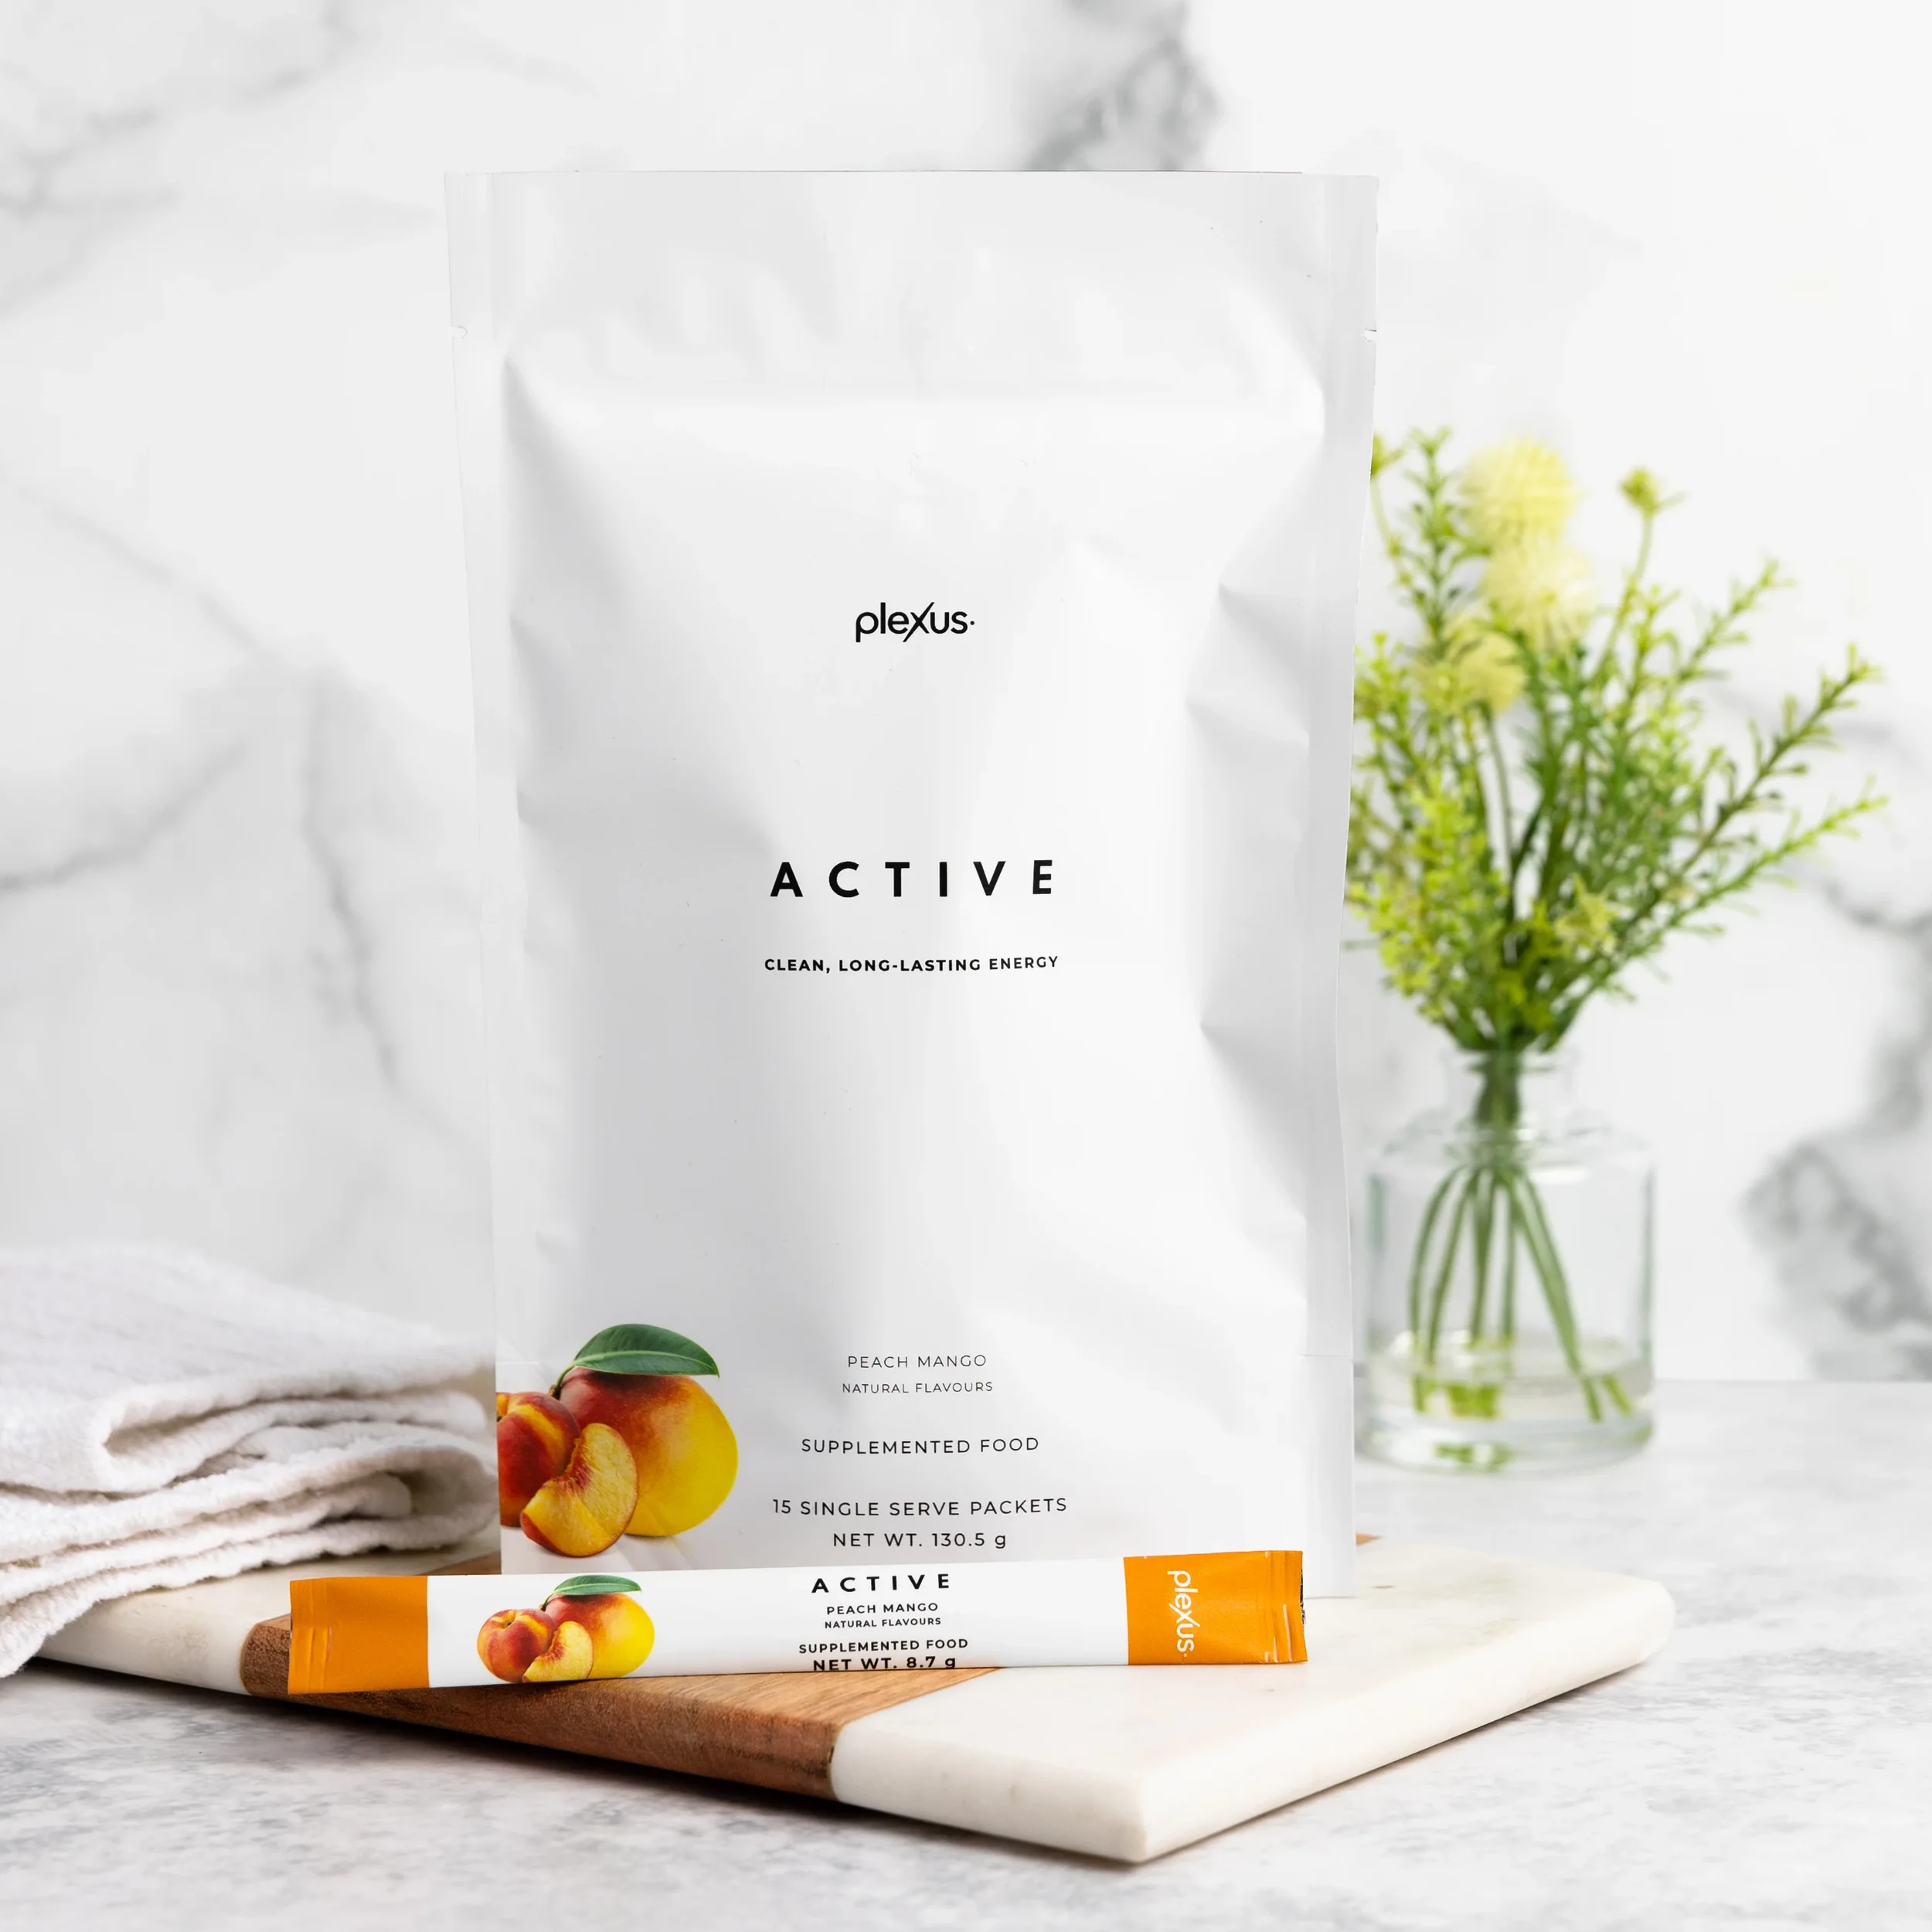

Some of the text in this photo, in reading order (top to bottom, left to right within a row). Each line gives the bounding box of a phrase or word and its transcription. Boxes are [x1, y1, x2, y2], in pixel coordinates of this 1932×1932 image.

[770, 859, 1053, 898] ACTIVE
[764, 955, 1058, 975] CLEAN, LONG-LASTING ENERGY
[848, 1354, 987, 1369] PEACH MANGO
[842, 1381, 993, 1394] NATURAL FLAVOURS
[801, 1437, 1039, 1455] SUPPLEMENTED FOOD
[772, 1497, 1066, 1516] 15 SINGLE SERVE PACKETS
[833, 1532, 1006, 1549] NET WT. 130.5 g
[811, 1573, 950, 1594] ACTIVE
[826, 1602, 938, 1615] PEACH MANGO
[825, 1617, 941, 1629] NATURAL FLAVOURS
[798, 1638, 968, 1655] SUPPLEMENTED FOOD
[813, 1655, 956, 1671] NET WT. 8.7 g
